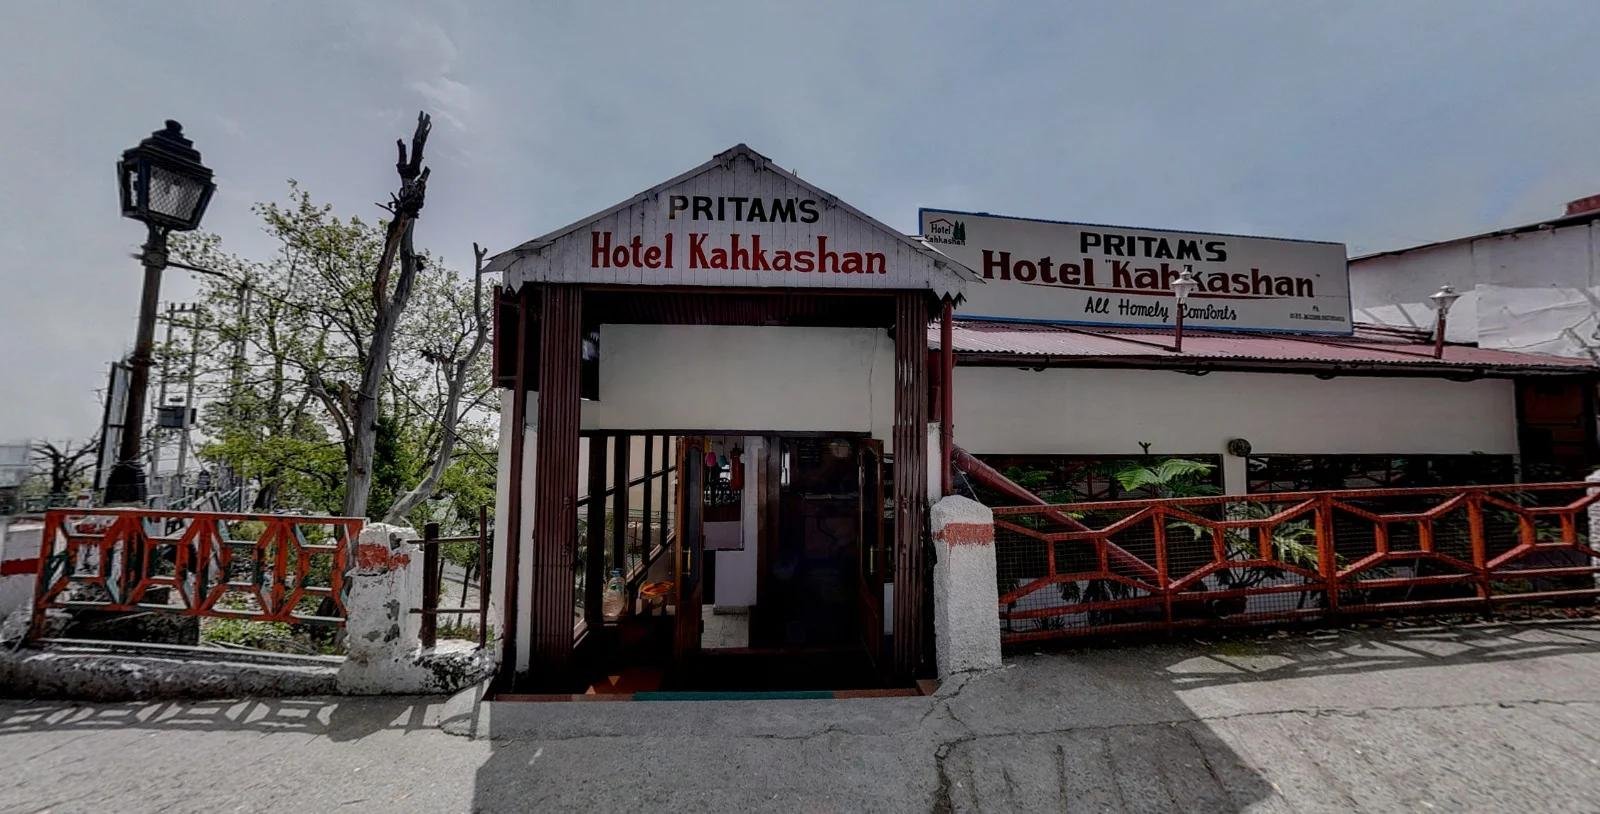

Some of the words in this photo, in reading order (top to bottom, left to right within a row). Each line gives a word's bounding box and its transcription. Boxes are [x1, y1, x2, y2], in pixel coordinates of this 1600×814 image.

[669, 195, 820, 223] PRITAM'S
[930, 223, 951, 235] Hotel
[590, 231, 674, 269] Hotel
[688, 233, 887, 275] Kahkashan
[1080, 231, 1228, 263] PRITAM'S
[982, 248, 1095, 287] Hotel
[1084, 296, 1110, 315] All
[1119, 298, 1169, 323] Homely
